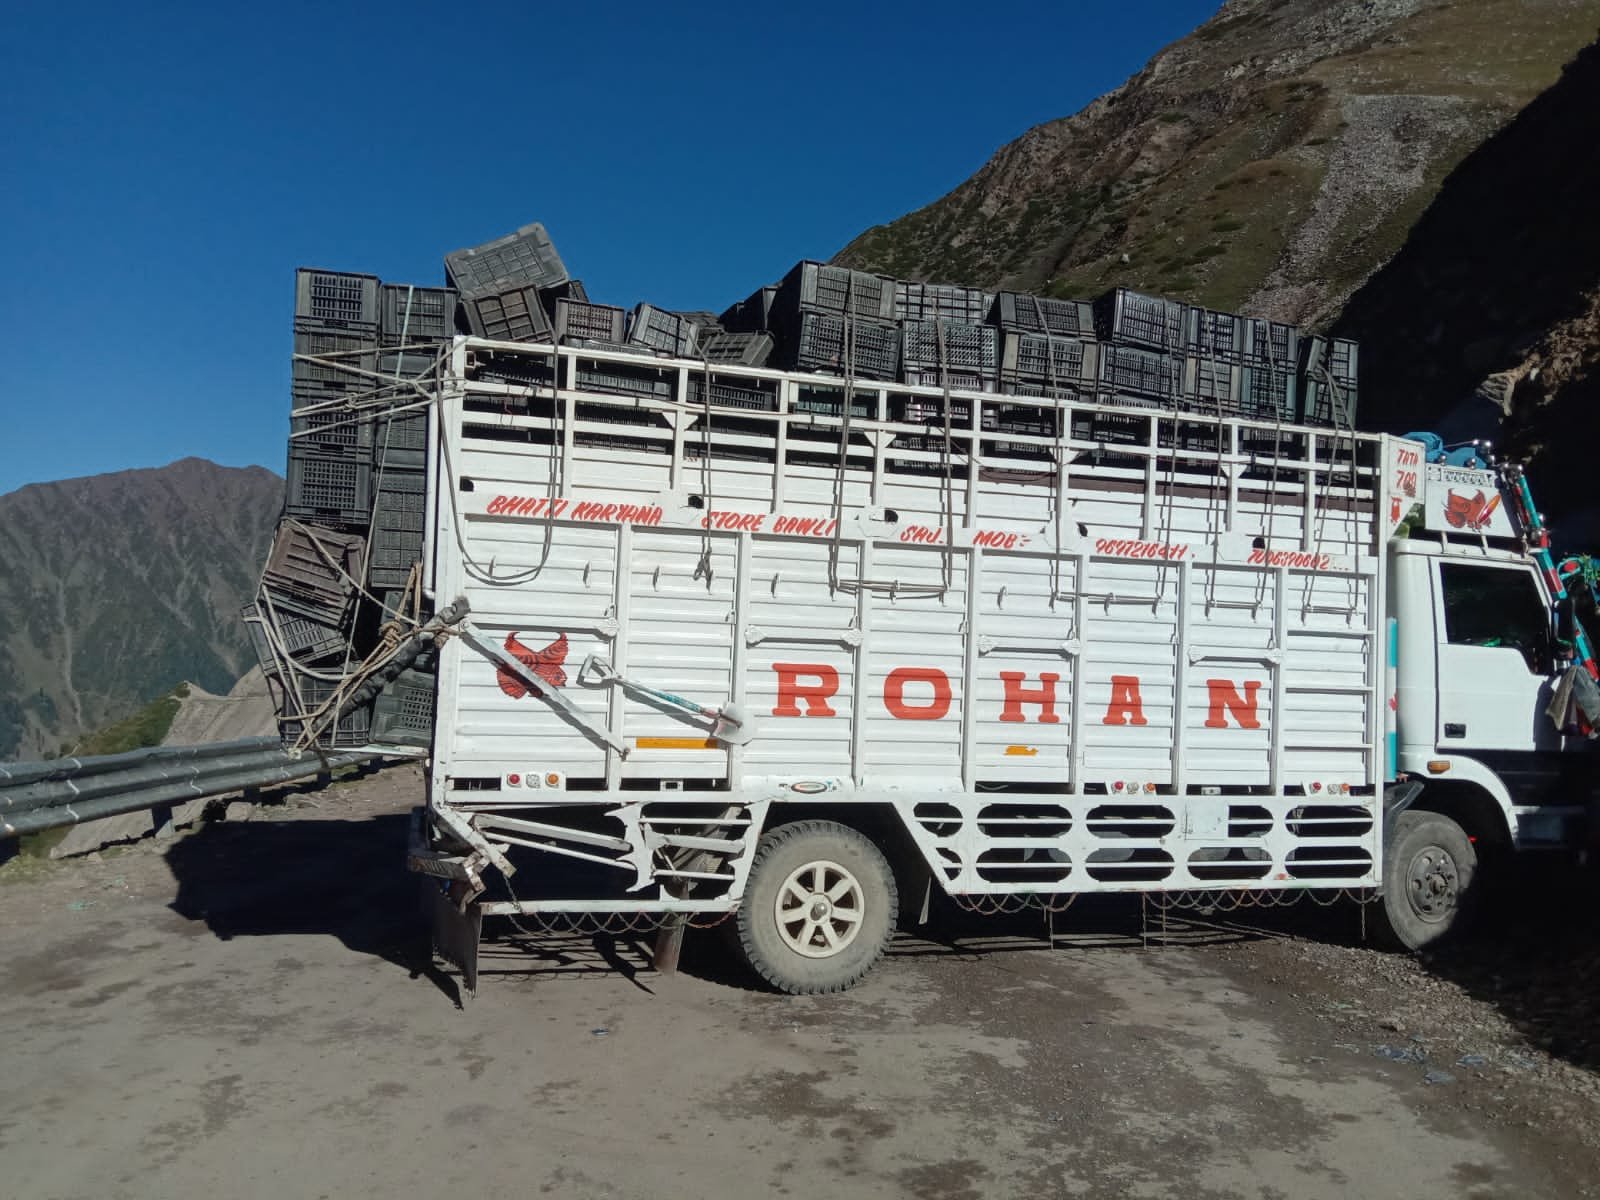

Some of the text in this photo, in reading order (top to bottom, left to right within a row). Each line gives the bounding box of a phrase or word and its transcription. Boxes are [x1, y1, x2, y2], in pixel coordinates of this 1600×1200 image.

[1397, 448, 1419, 466] TATA
[486, 495, 569, 518] BHATTI
[570, 501, 663, 526] KARYANA
[701, 511, 766, 533] STORE
[772, 515, 837, 537] BAWLI
[772, 663, 1262, 729] ROHAN
